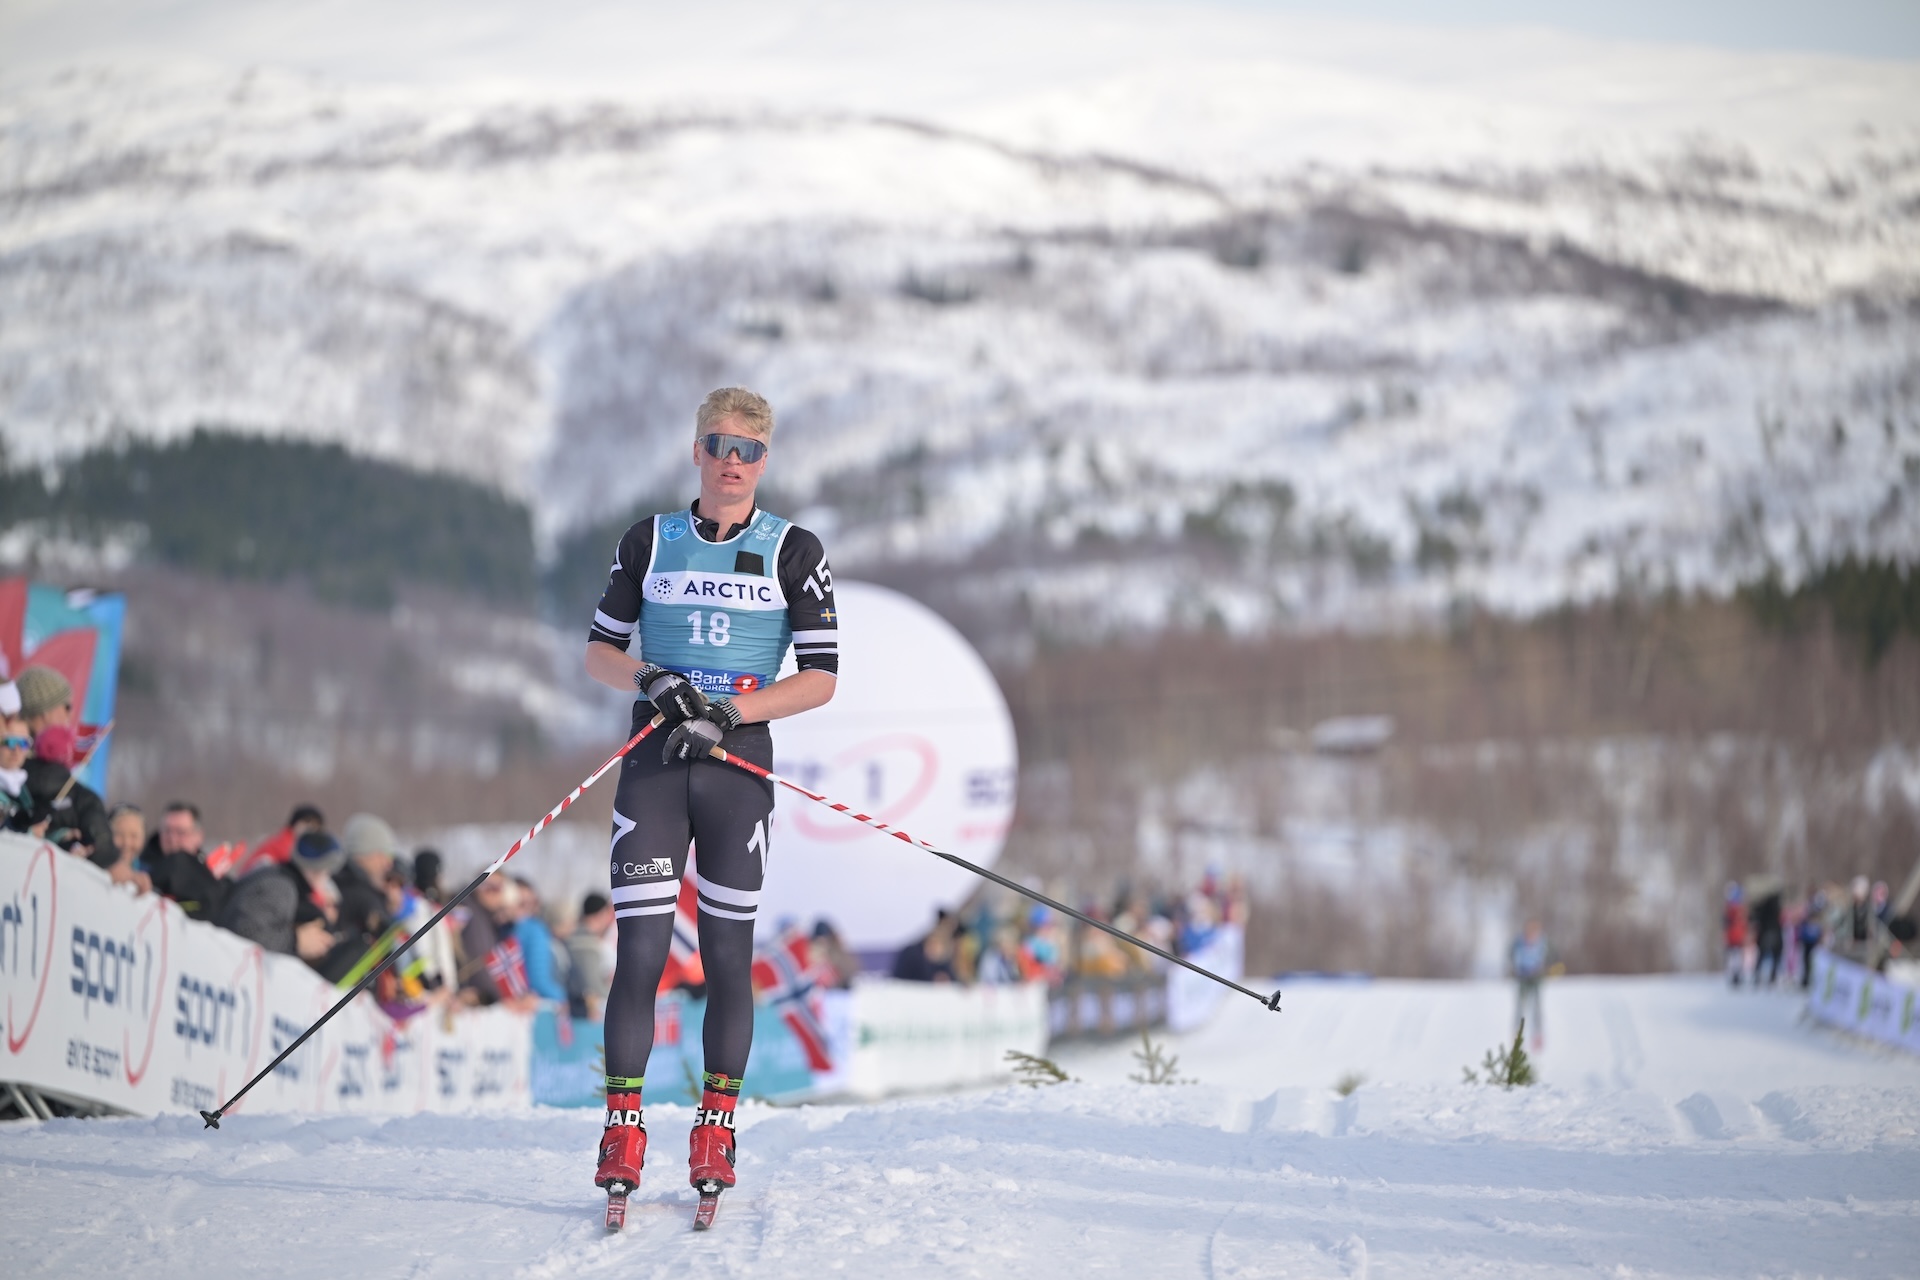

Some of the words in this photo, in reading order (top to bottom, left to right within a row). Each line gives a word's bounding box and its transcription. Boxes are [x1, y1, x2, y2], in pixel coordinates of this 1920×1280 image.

[683, 579, 772, 602] ARCTIC
[687, 610, 731, 647] 18
[623, 860, 672, 876] CeraVe
[70, 920, 136, 1021] sport
[175, 970, 237, 1062] sport
